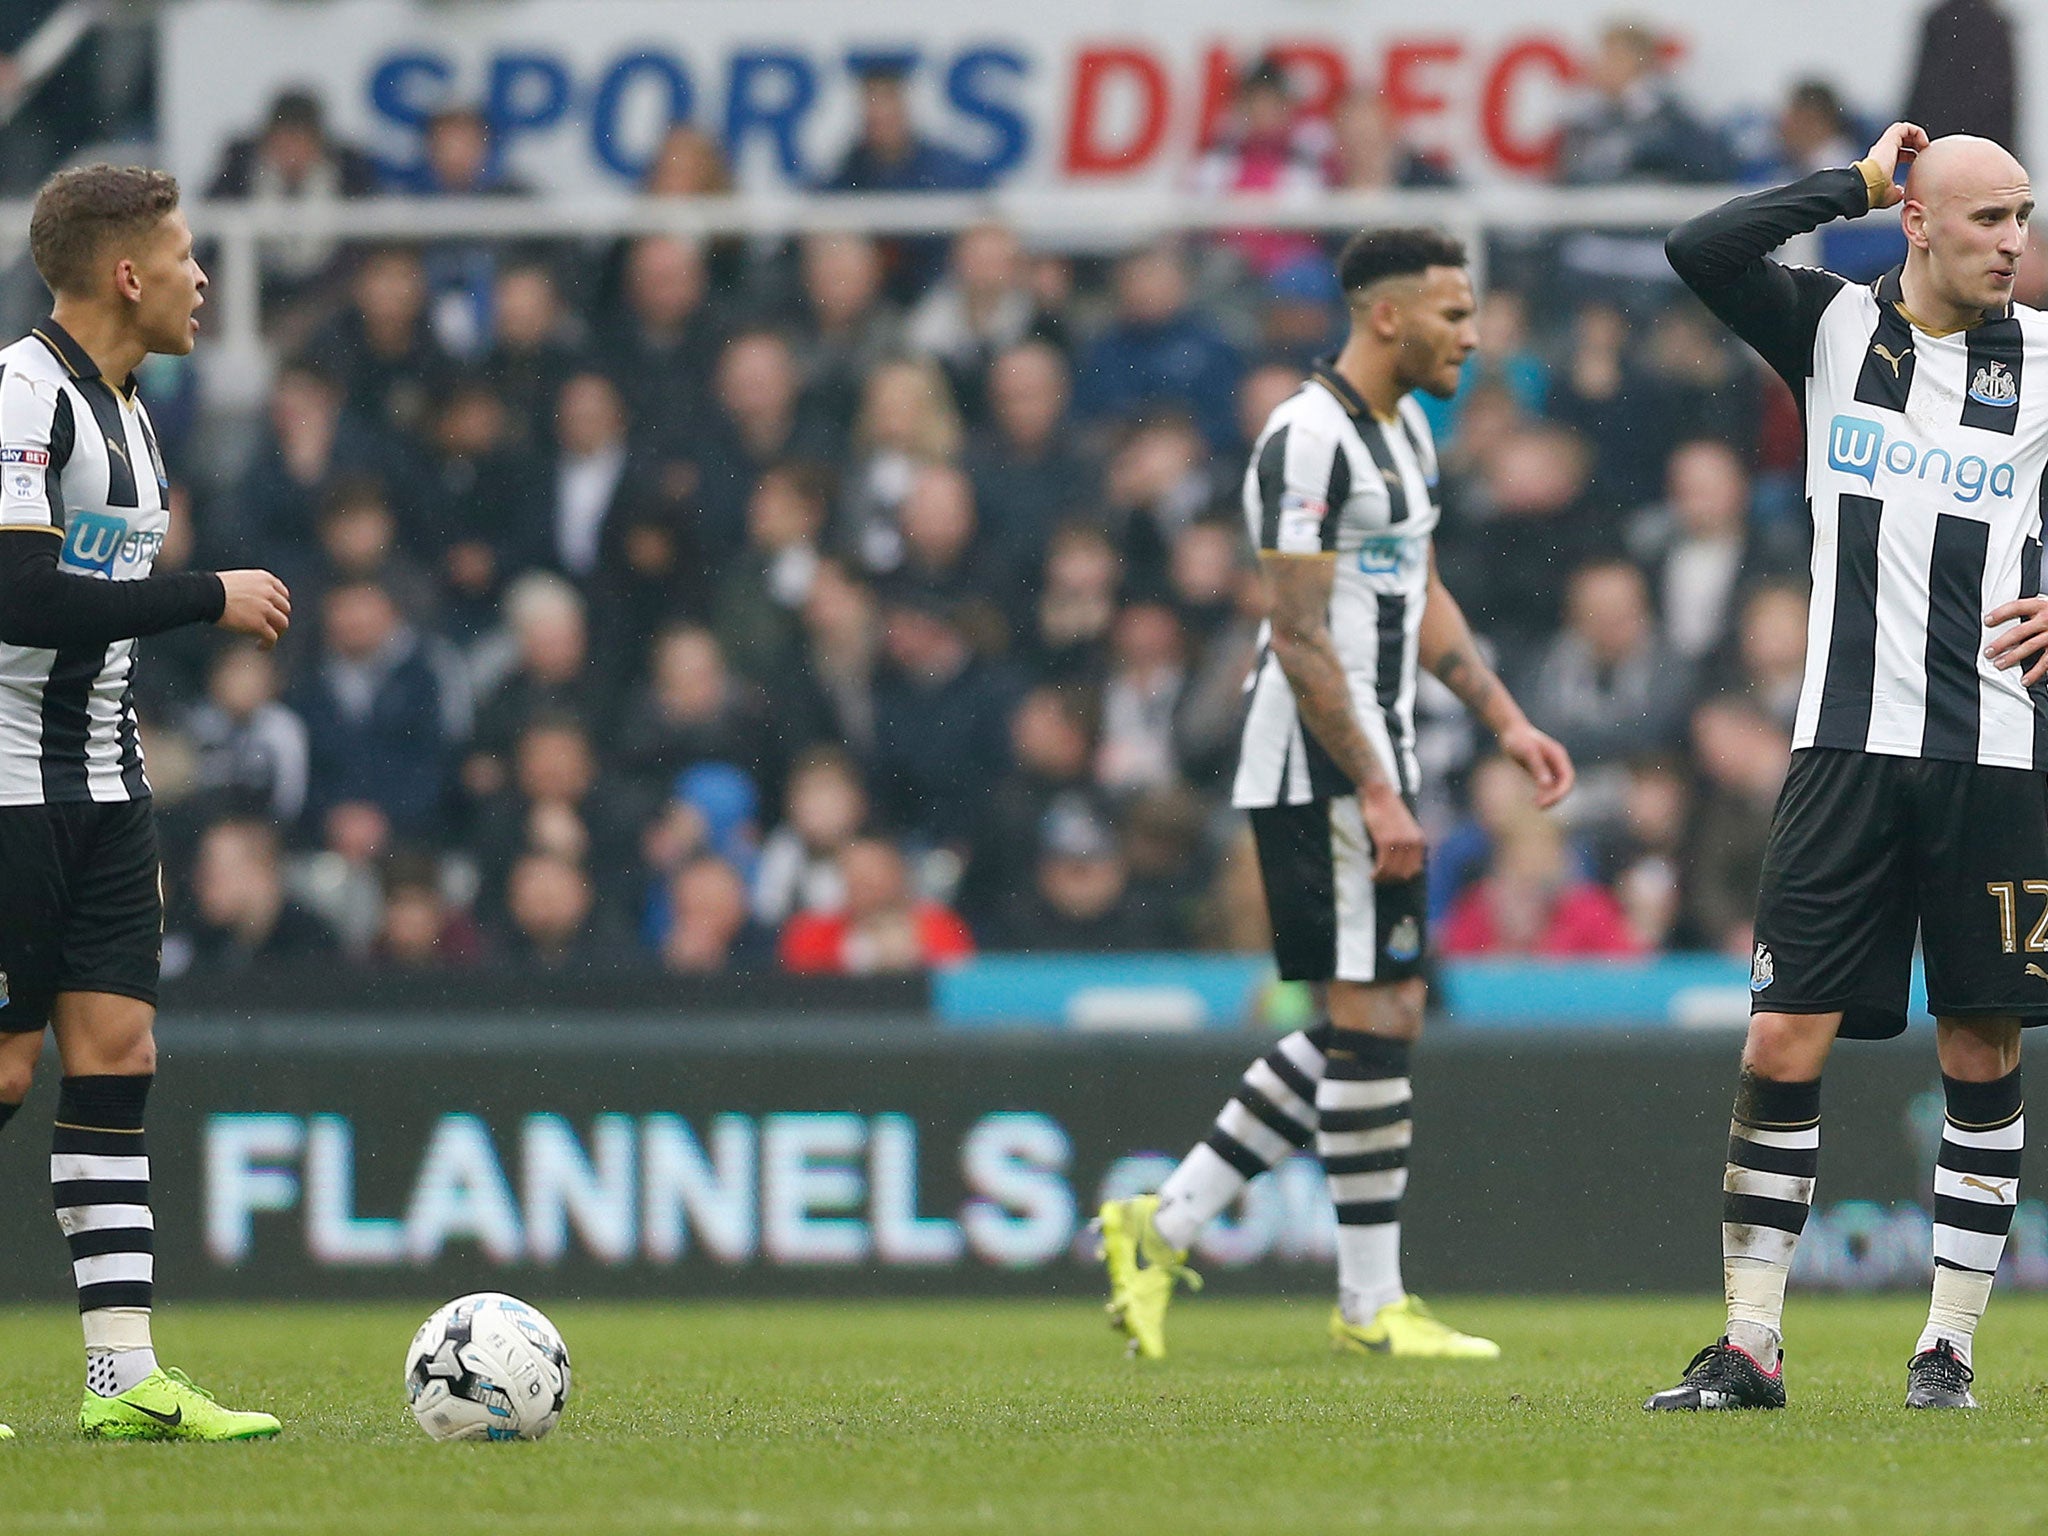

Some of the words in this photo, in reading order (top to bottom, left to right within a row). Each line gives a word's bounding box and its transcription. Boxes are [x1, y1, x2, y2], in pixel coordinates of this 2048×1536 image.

[1062, 38, 1688, 177] DIREC
[25, 451, 47, 464] BET
[1986, 880, 2048, 953] 12
